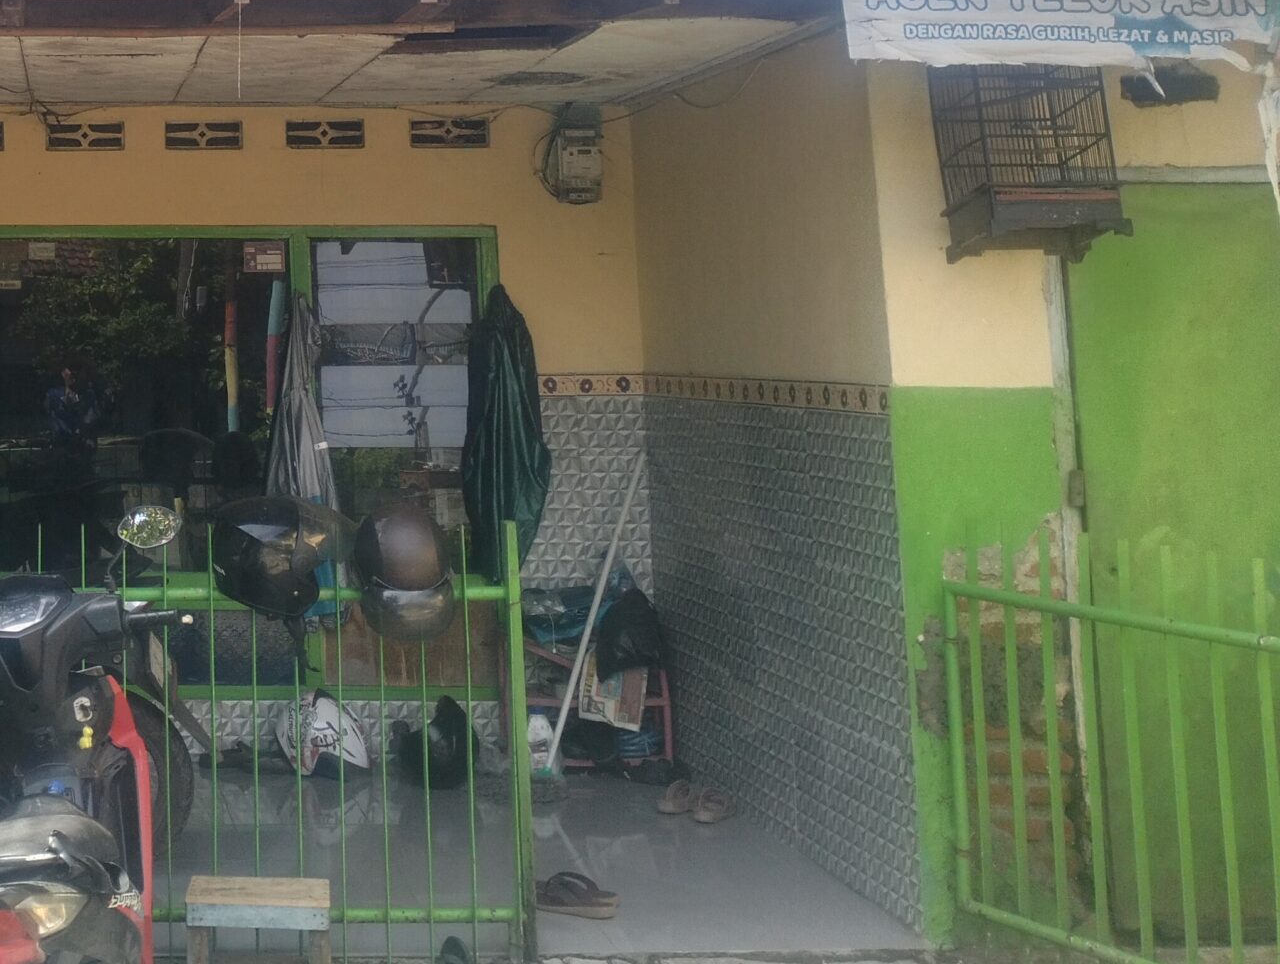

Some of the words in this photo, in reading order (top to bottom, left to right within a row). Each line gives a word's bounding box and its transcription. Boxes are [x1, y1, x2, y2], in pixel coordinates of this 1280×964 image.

[903, 22, 979, 40] DENGAN
[981, 24, 1031, 41] RASA
[1032, 24, 1096, 44] GURIH,
[1097, 26, 1151, 44] LEZAT
[1155, 28, 1169, 44] &
[1172, 29, 1234, 46] MASIR
